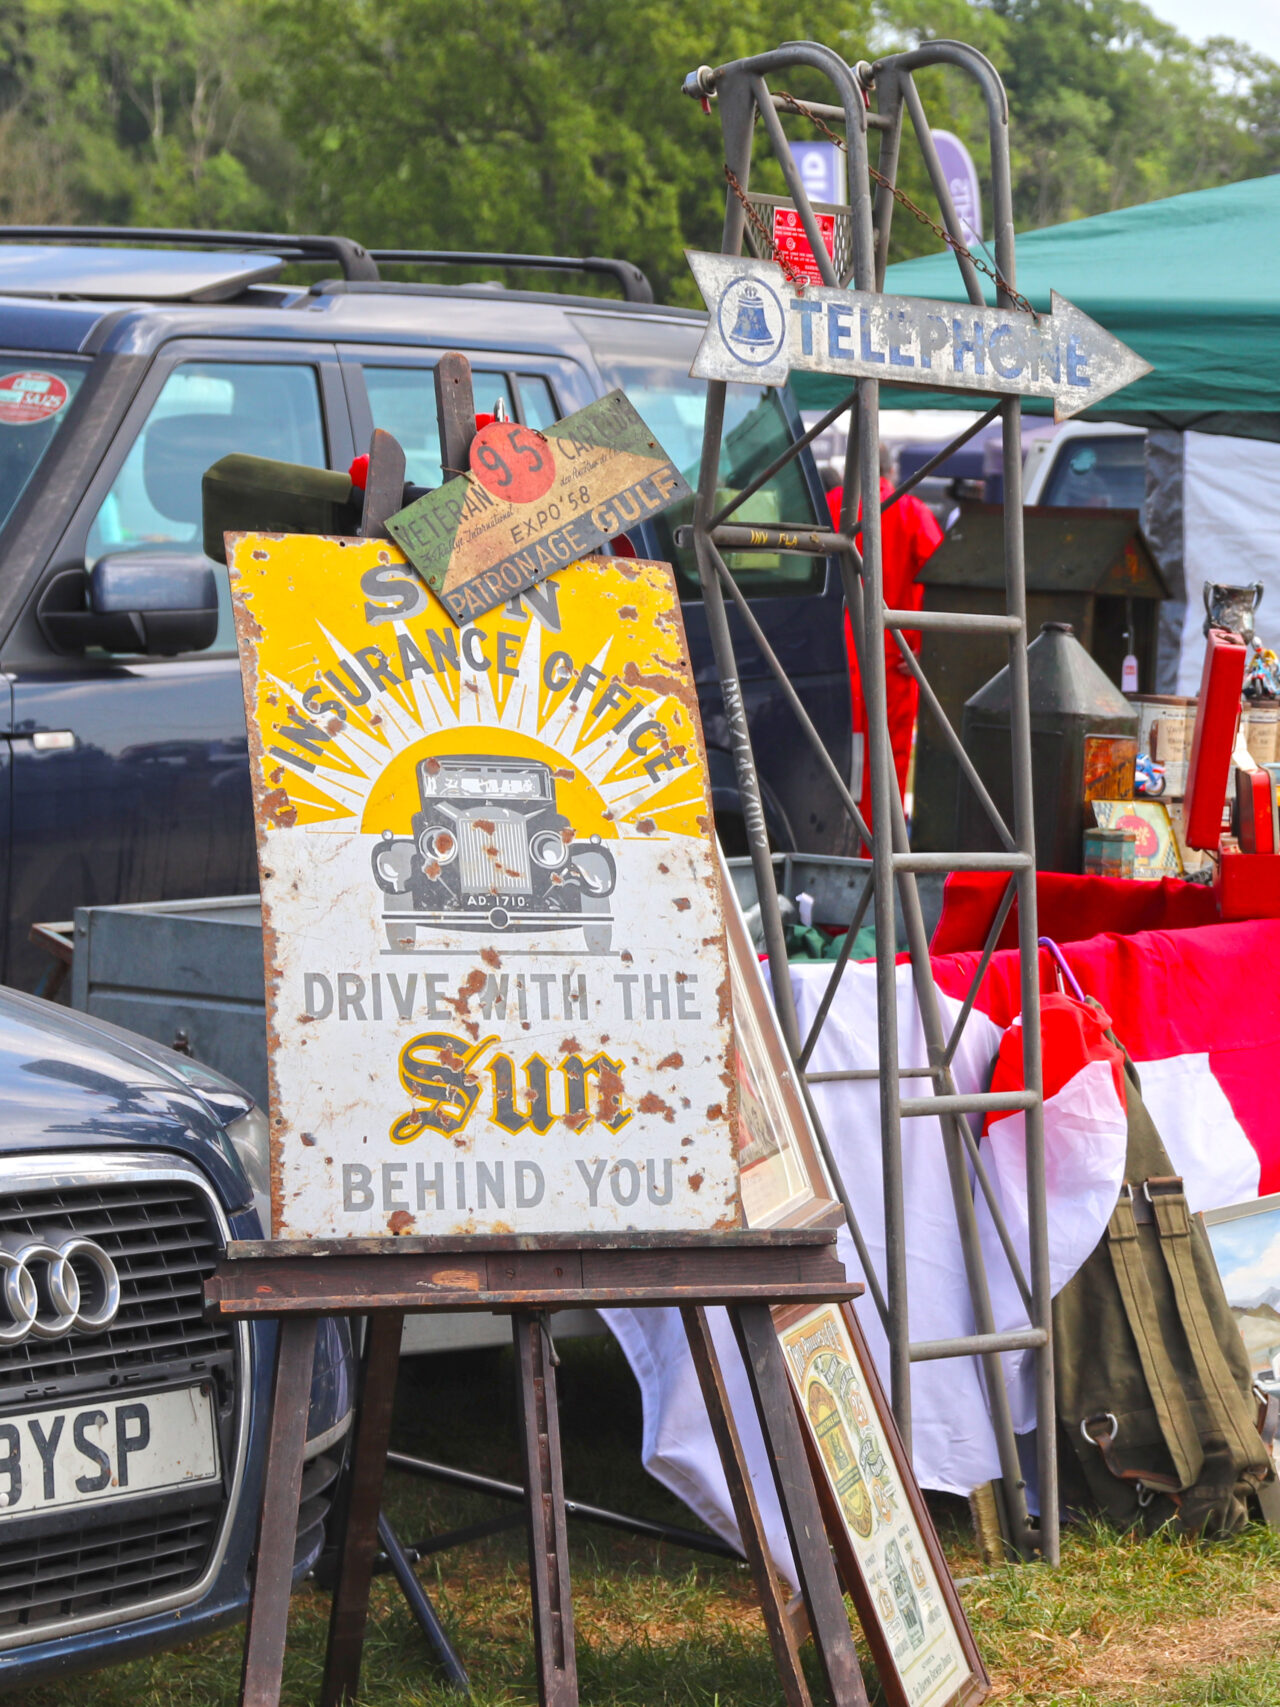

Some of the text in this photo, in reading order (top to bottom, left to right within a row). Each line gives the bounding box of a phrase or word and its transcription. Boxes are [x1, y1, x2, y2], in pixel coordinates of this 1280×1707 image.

[790, 297, 1091, 387] TELEPHONE
[394, 484, 494, 551] VETERAN
[556, 423, 600, 461] CAR
[477, 428, 544, 487] 95
[447, 468, 679, 615] PATRONAGE GULF
[463, 504, 514, 543] International
[359, 562, 563, 635] SN
[268, 627, 522, 774] INSURANCE
[303, 972, 701, 1021] DRIVE WITH THE
[389, 1031, 634, 1145] Sun
[342, 1158, 674, 1213] BEHIND YOU
